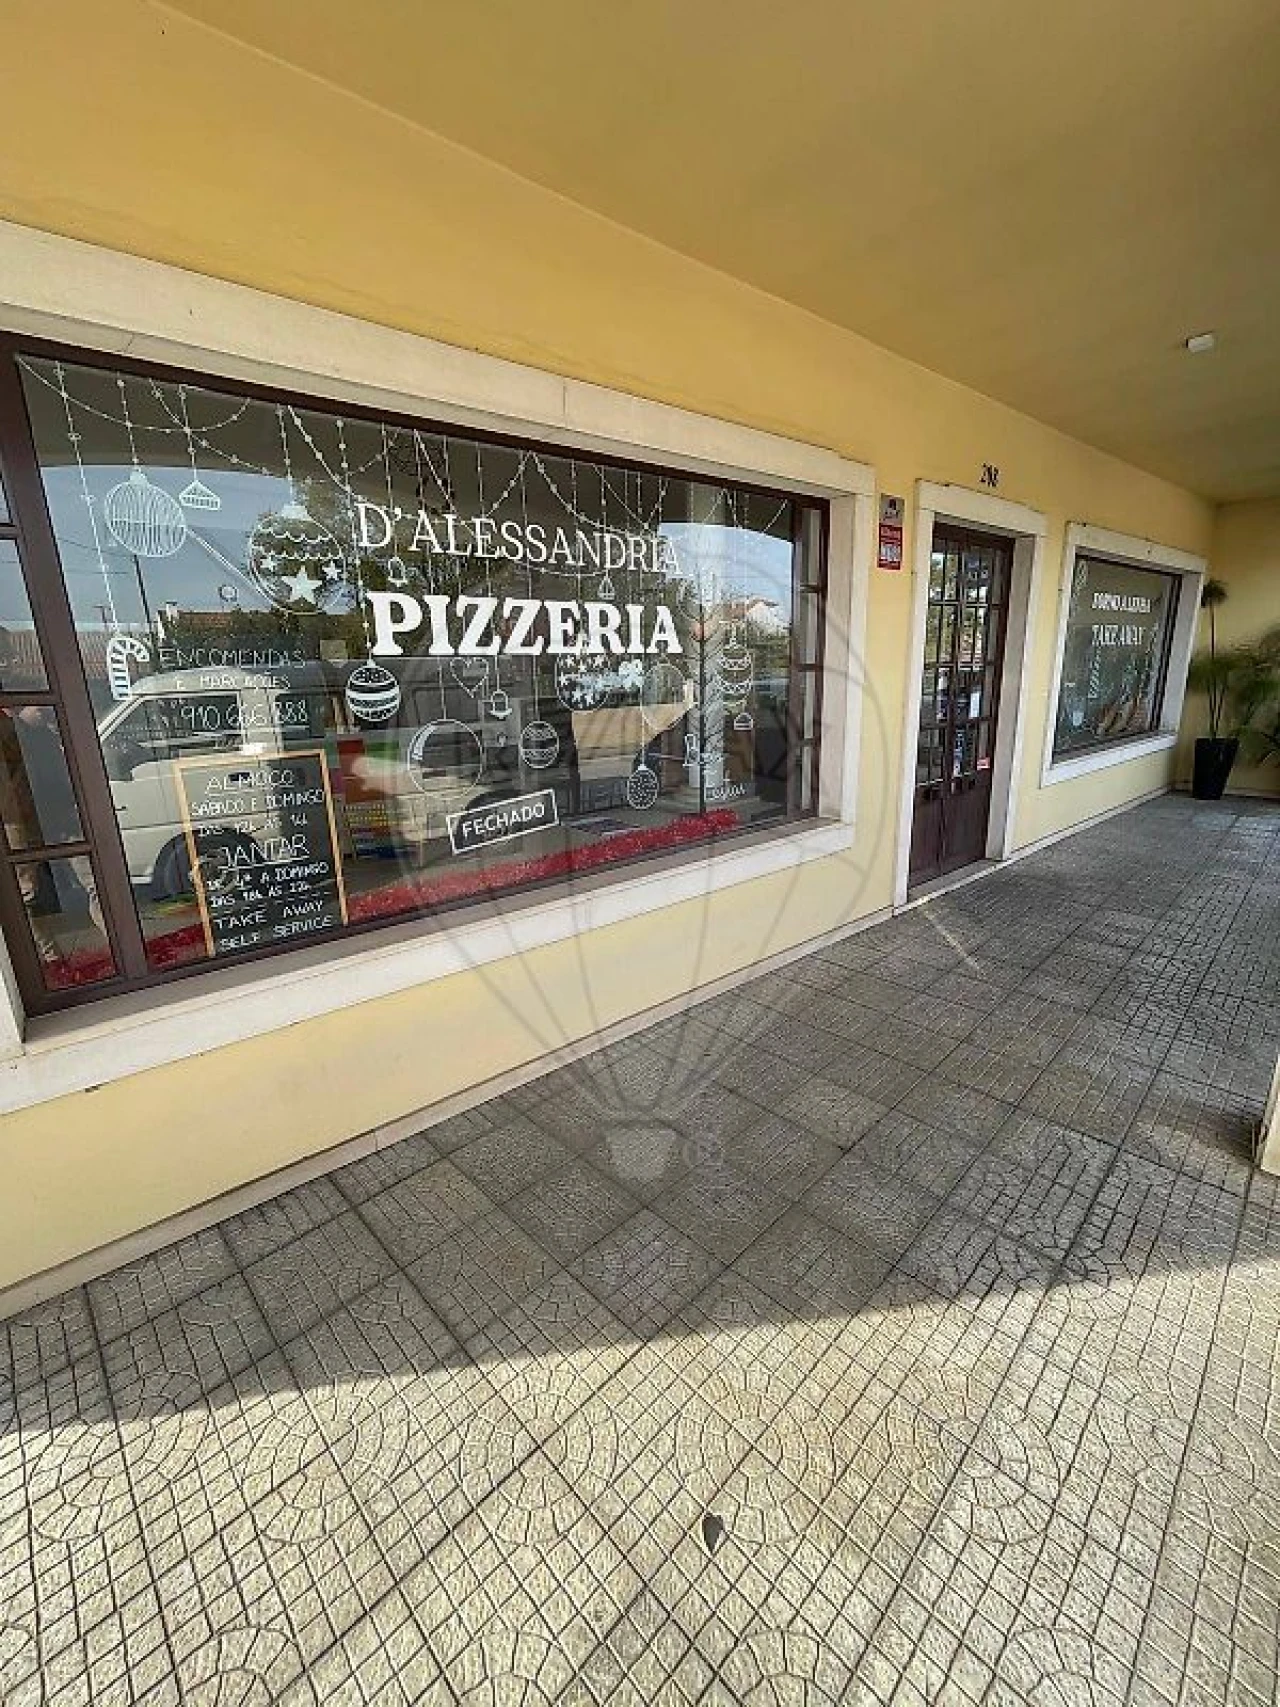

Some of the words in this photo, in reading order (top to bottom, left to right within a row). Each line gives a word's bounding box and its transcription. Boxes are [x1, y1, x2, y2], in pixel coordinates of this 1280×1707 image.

[366, 590, 684, 656] PIZZERIA
[159, 648, 306, 669] ENCOMENDAS
[181, 704, 221, 731] 910
[205, 769, 295, 795] ALMOÇO
[461, 801, 546, 838] FECHADO
[220, 833, 311, 867] JANTAR
[274, 861, 330, 883] DOMINGO
[213, 910, 268, 930] TAKE
[283, 900, 324, 918] AWAY
[219, 930, 261, 952] SELF
[272, 914, 333, 939] SERVICE
